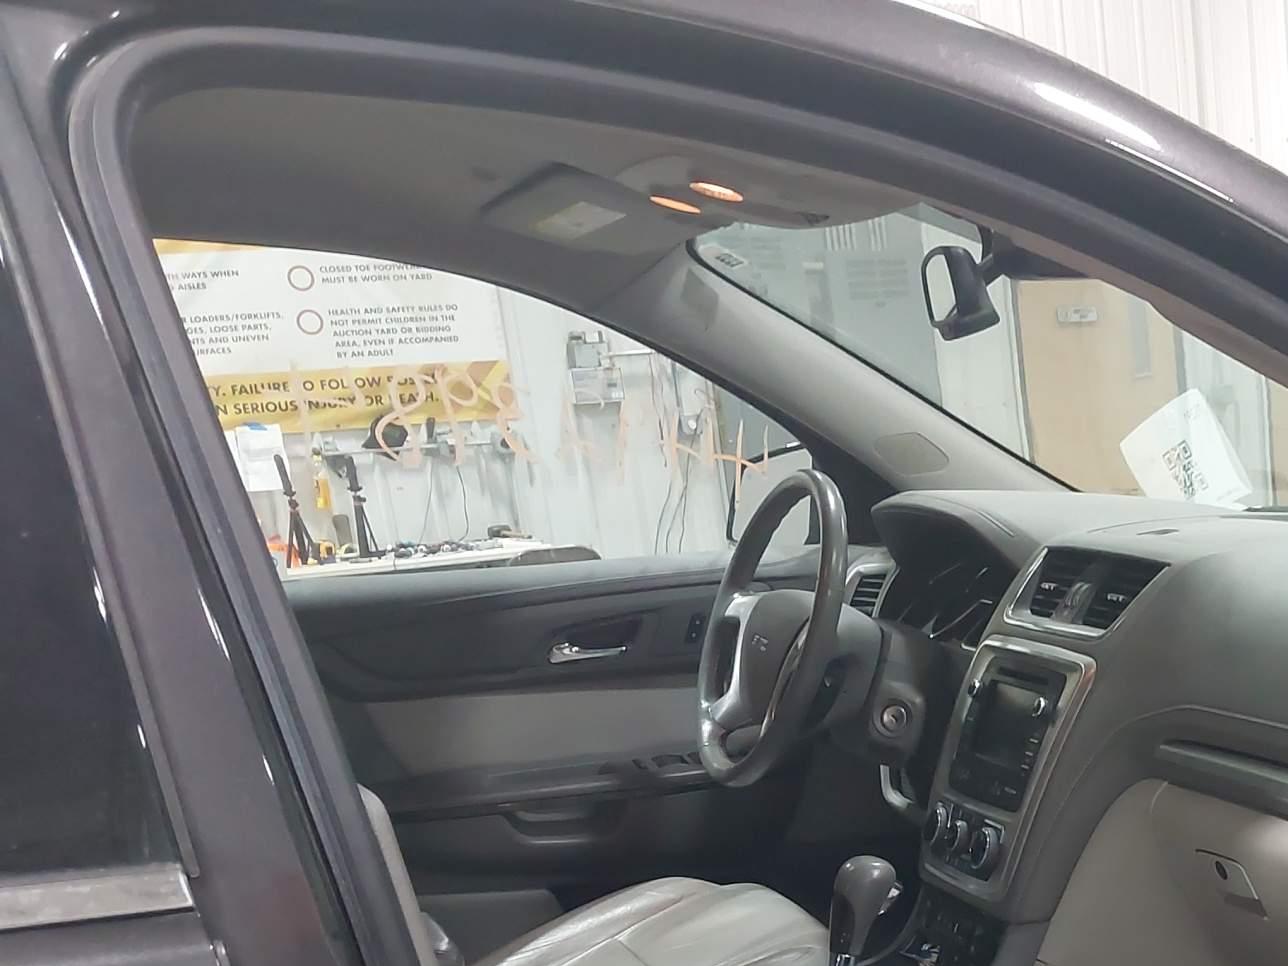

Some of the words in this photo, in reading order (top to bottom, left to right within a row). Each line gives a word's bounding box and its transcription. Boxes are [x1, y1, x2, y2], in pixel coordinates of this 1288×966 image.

[181, 271, 208, 280] WAYS
[210, 269, 239, 278] WHEN
[319, 265, 352, 273] CLOSED
[321, 275, 345, 284] MUST
[361, 274, 390, 283] WORN
[392, 273, 407, 282] ON
[409, 272, 433, 281] YARD
[178, 282, 207, 291] AISLES
[328, 307, 361, 316] HEALTH
[364, 307, 383, 315] AND
[386, 305, 416, 314] SAFETY
[418, 304, 443, 313] RULES
[445, 303, 458, 312] DO
[330, 318, 349, 327] NOT
[351, 317, 382, 326] PERMIT
[385, 315, 426, 325] CHILDREN
[428, 315, 438, 323] IN
[441, 314, 456, 322] THE
[209, 324, 238, 334] LOOSE
[333, 328, 372, 338] AUCTION
[375, 327, 398, 336] YARD
[400, 326, 413, 335] OR
[415, 325, 452, 334] BIDDING
[208, 336, 229, 345] AND
[231, 333, 270, 344] UNEVEN
[363, 338, 386, 347] EVEN
[388, 337, 395, 346] IF
[398, 335, 460, 345] ACCOMPANIED
[336, 351, 347, 359] BY
[351, 350, 364, 358] AN
[367, 348, 394, 358] ADULT
[319, 376, 381, 390] FOLOW
[233, 400, 298, 415] SERIOUS
